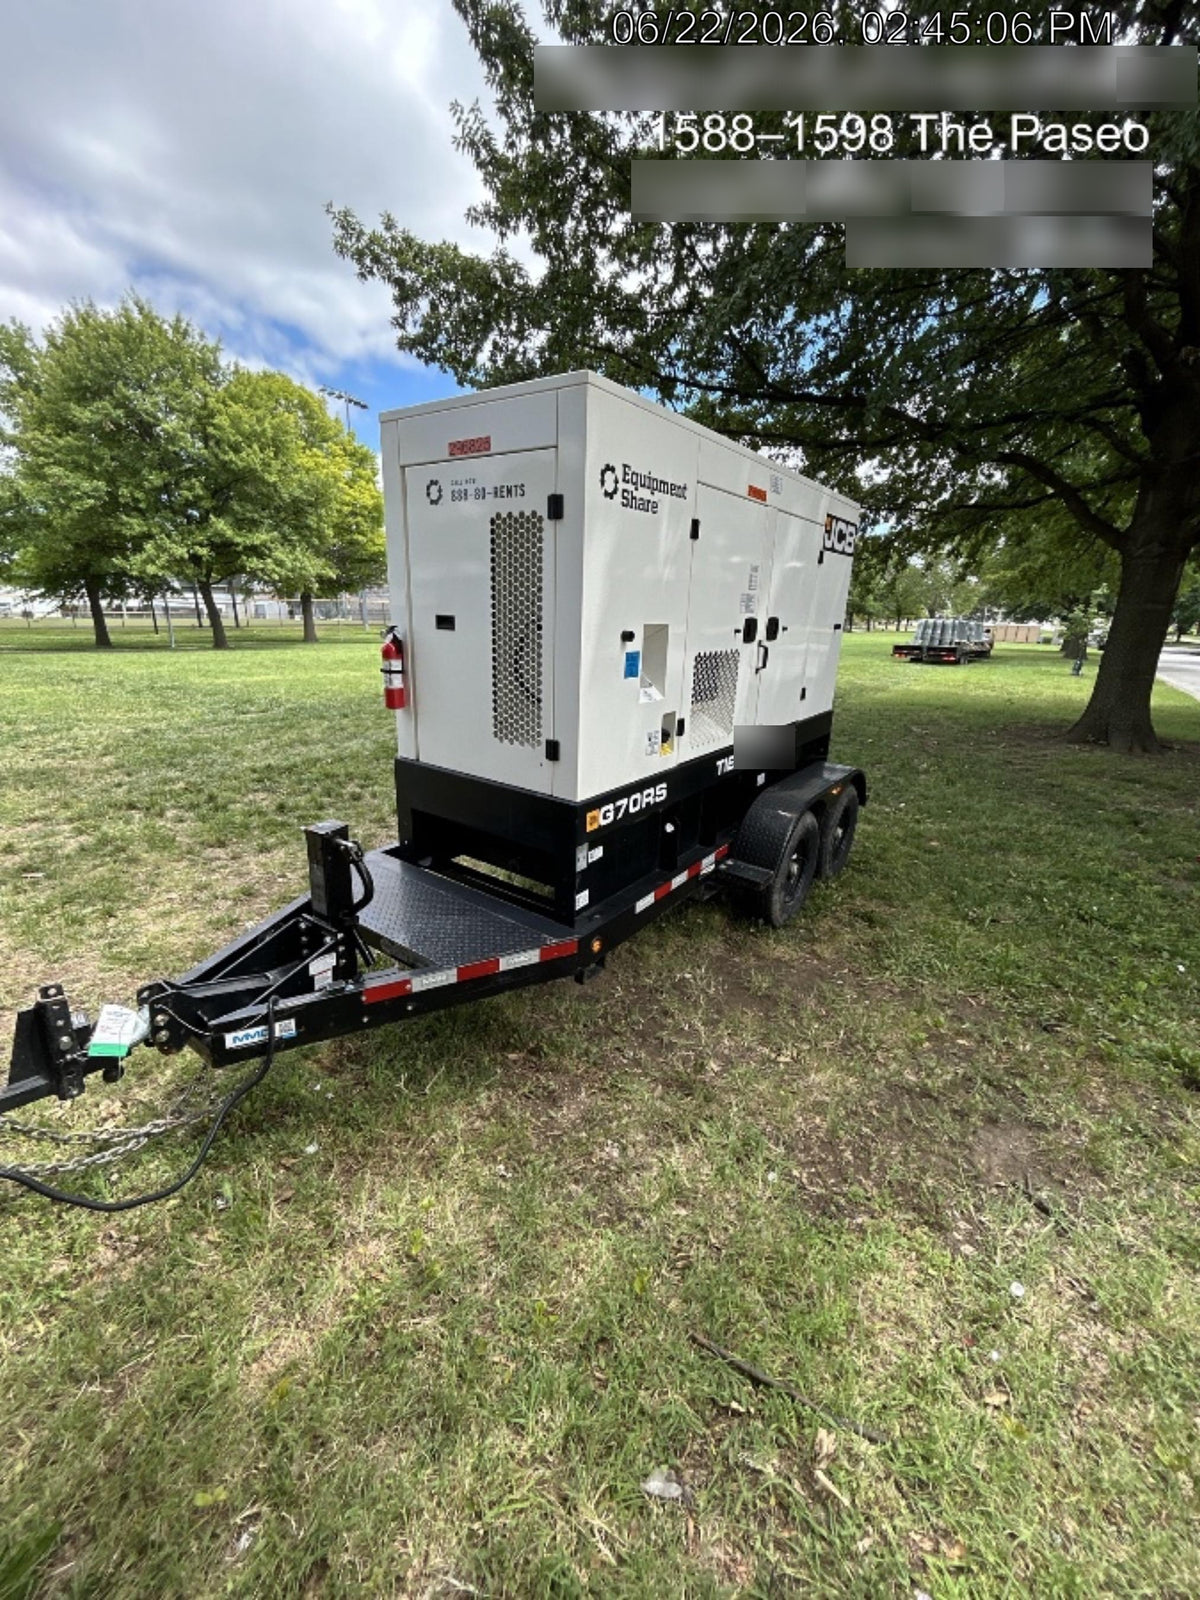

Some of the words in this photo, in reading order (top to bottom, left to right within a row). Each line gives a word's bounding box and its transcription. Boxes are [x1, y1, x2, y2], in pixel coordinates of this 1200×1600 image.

[621, 463, 687, 500] Equipment
[621, 488, 659, 514] Share
[824, 516, 857, 555] JCB
[599, 782, 669, 826] G70RS
